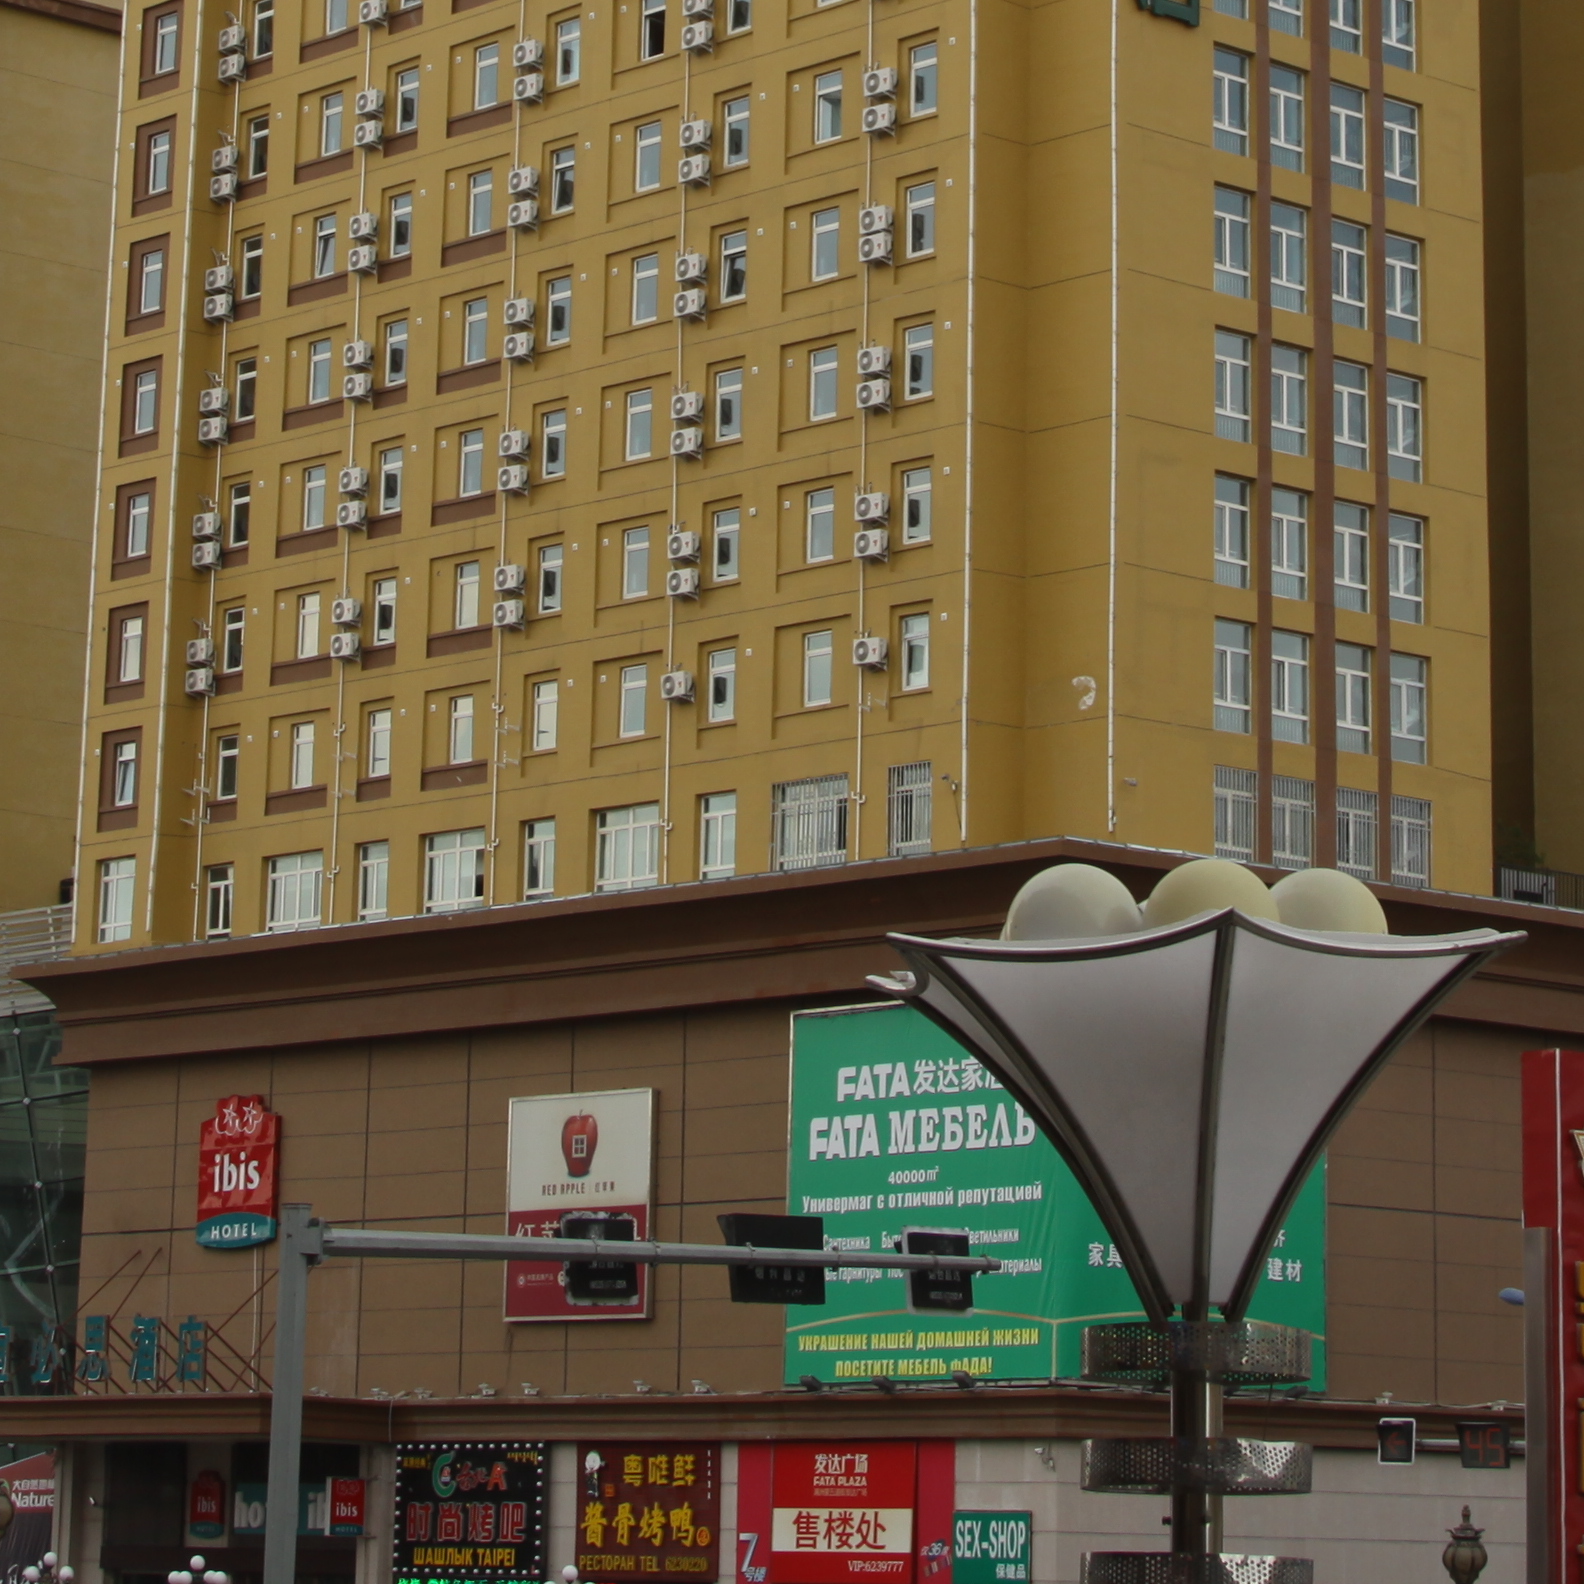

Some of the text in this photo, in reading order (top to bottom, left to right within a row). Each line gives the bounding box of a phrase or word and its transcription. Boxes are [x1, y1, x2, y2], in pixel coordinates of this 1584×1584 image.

[837, 1056, 1005, 1103] FATA 发达家居
[809, 1102, 1036, 1161] FATA МЕБЕЛЬ
[213, 1151, 260, 1193] ibis
[542, 1183, 557, 1196] RED
[560, 1182, 586, 1195] APPLE
[802, 1181, 1043, 1214] Универмаг с отличной репутацией
[211, 1222, 257, 1239] HOTEL
[798, 1328, 1040, 1352] УКРАШЕНИЕ НАШЕЙ ДОМАШНЕЙ ЖИЗНИ
[835, 1359, 895, 1377] ПОСЕТИТЕ
[898, 1357, 947, 1376] МЕБЕЛЬ
[1466, 1427, 1505, 1467] 45
[623, 1454, 696, 1487] 粤唯鲜
[814, 1453, 869, 1475] 发达广场
[813, 1476, 867, 1487] FATA PLAZA
[197, 1496, 216, 1514] ibis
[335, 1502, 359, 1517] ibis
[406, 1502, 527, 1543] 时尚烤吧
[580, 1501, 696, 1548] 酱骨烤鸭
[792, 1510, 886, 1550] 售楼处
[956, 1520, 1026, 1560] SEX-SHOP
[413, 1547, 516, 1566] ШАШЛЫК TAIPEI
[579, 1554, 635, 1571] РЕСТОРАН
[640, 1555, 660, 1572] TEL
[847, 1560, 904, 1573] VIP:6239777
[995, 1563, 1026, 1579] 保健品
